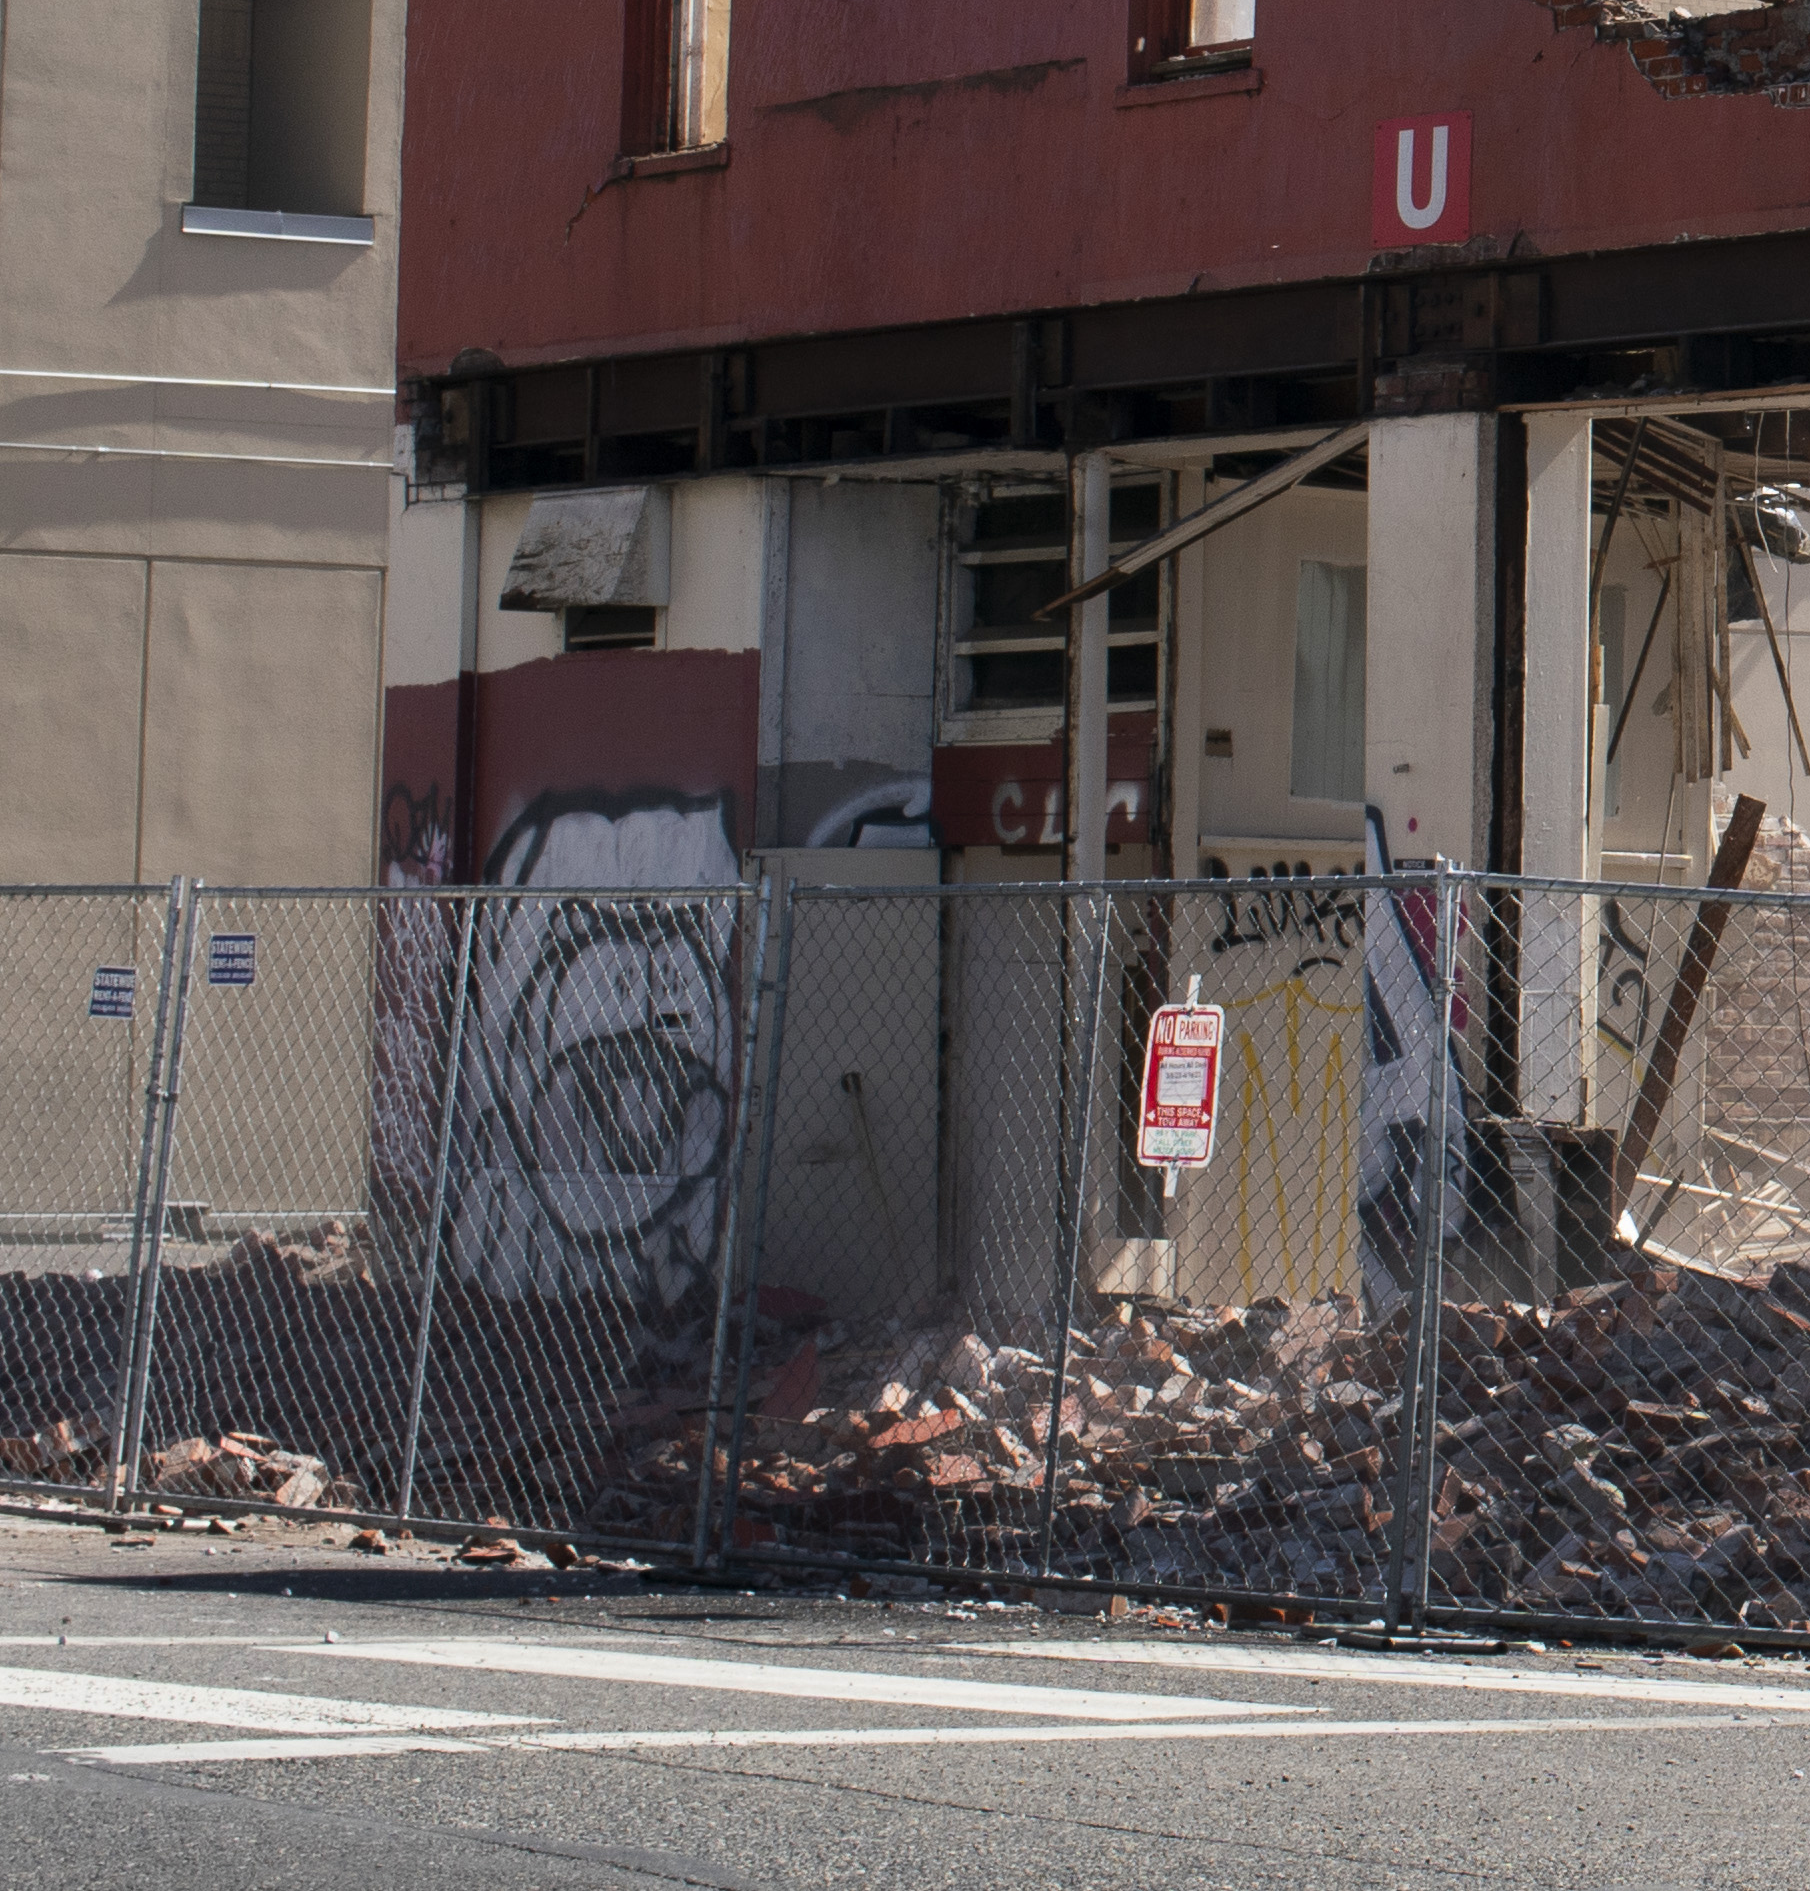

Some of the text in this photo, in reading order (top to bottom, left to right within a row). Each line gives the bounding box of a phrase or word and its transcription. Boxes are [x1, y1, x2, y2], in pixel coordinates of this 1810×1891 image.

[1396, 125, 1449, 230] U
[1154, 1015, 1214, 1045] NO PARKING
[1157, 1106, 1201, 1118] THIS SPACE
